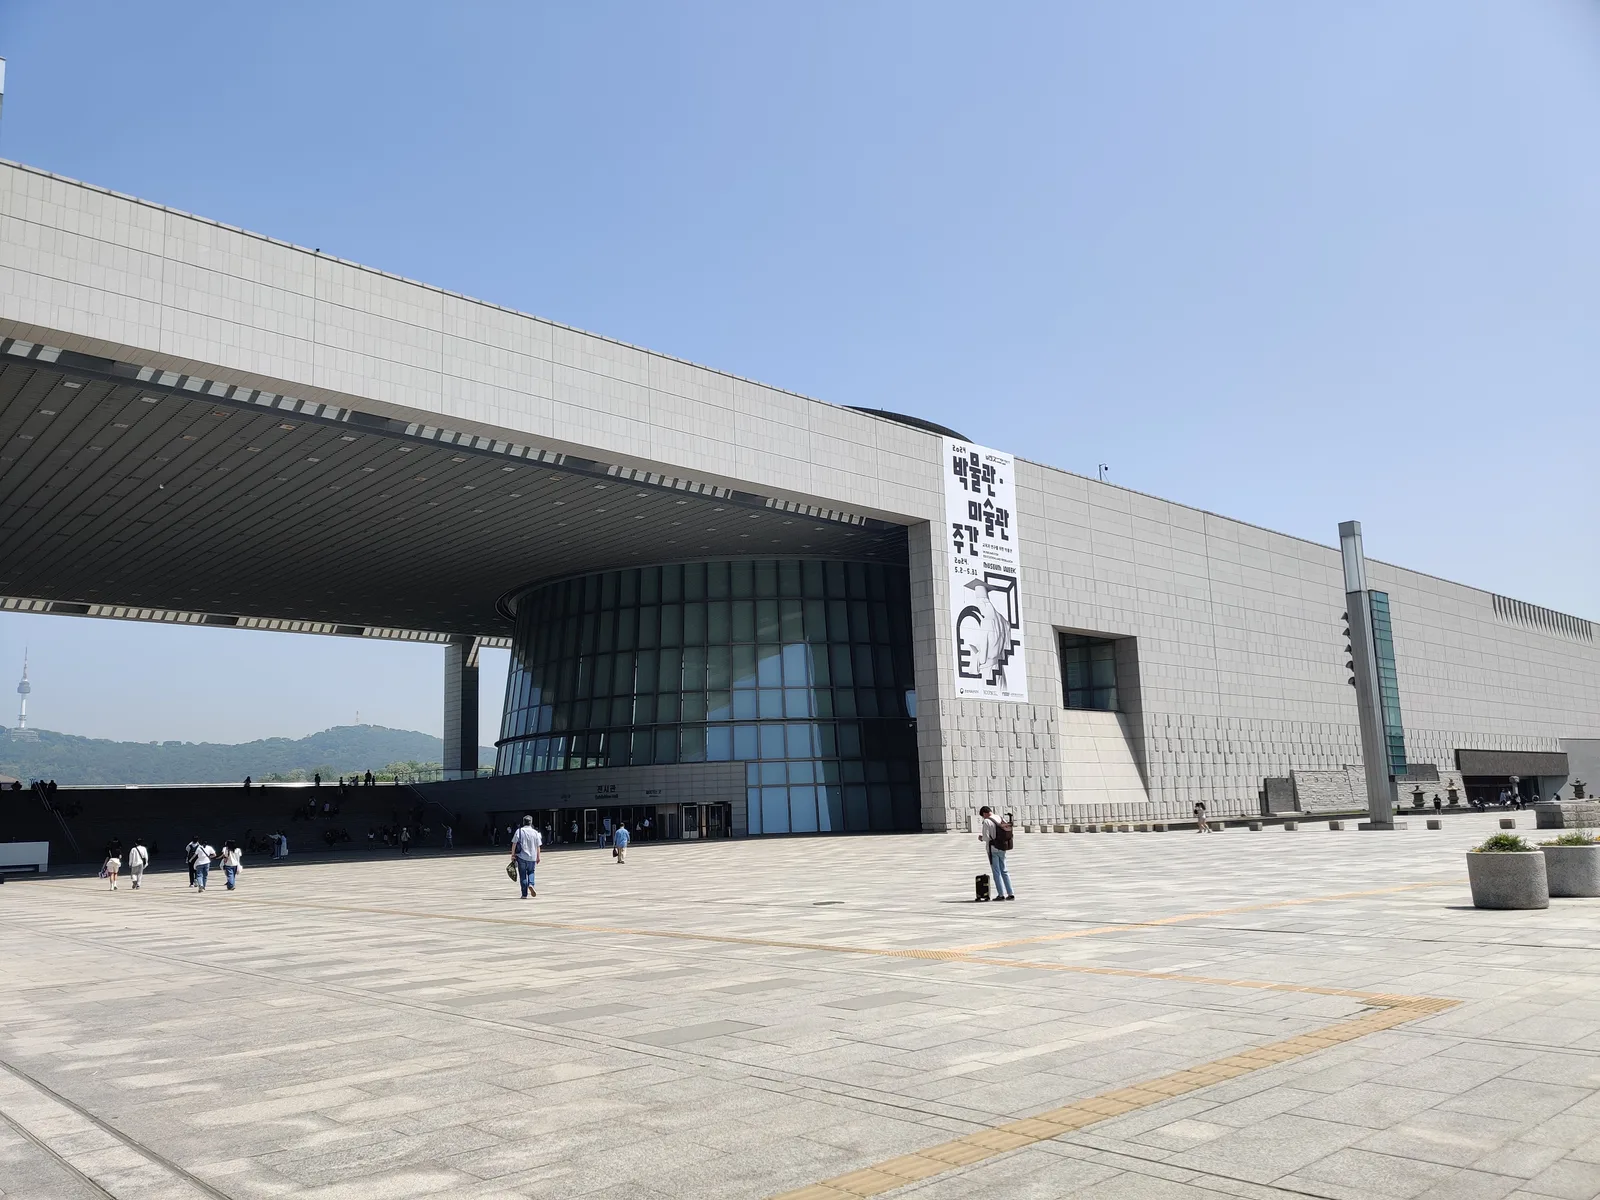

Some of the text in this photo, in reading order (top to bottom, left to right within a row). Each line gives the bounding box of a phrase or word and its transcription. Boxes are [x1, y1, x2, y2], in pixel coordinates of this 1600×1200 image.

[952, 444, 967, 454] 2024
[968, 497, 1010, 541] 미술관
[952, 522, 979, 557] 주간
[597, 784, 616, 793] 전시관
